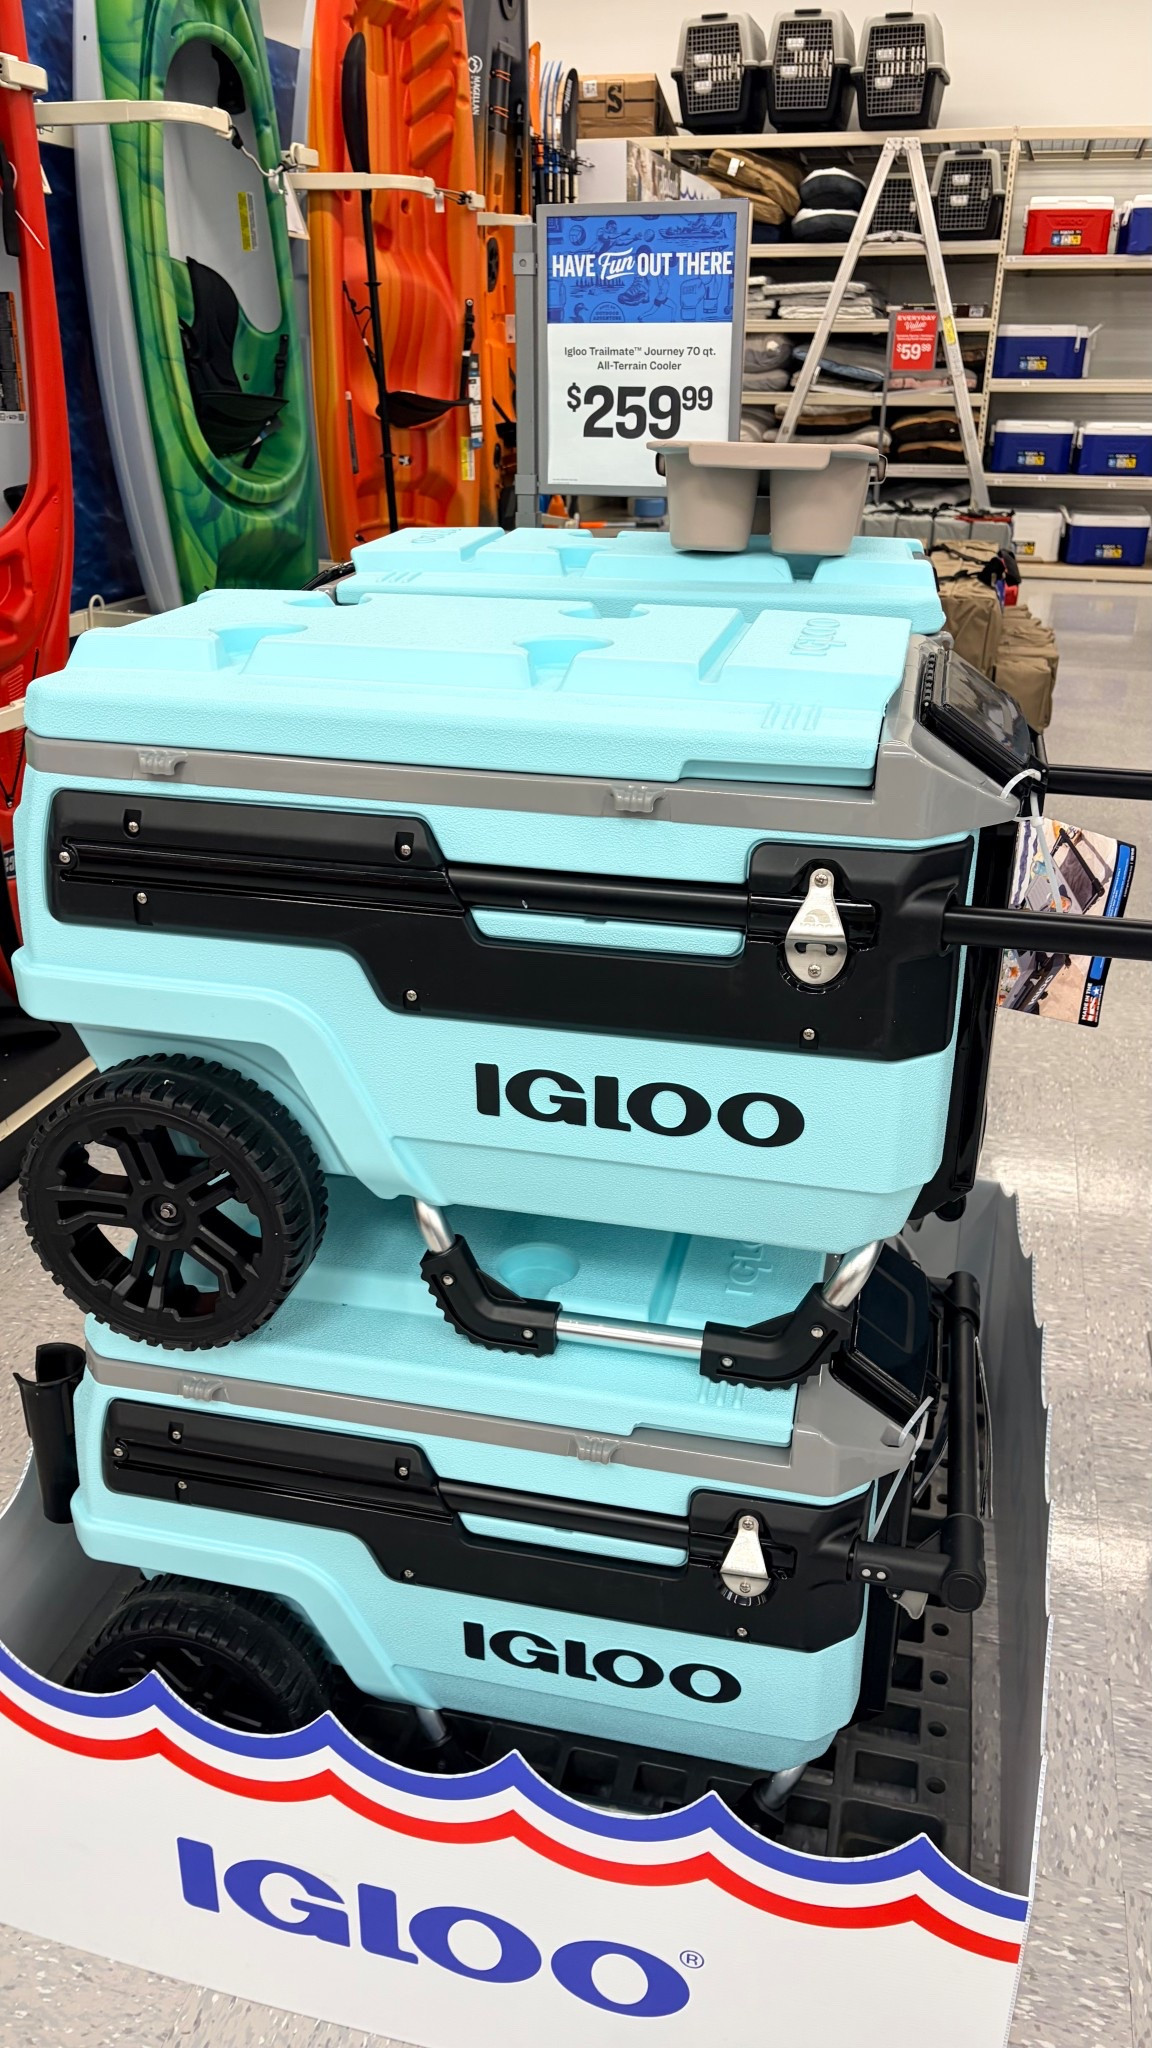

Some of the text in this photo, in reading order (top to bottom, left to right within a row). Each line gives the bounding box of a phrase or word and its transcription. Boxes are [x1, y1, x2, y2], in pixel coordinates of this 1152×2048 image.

[552, 247, 734, 281] HAVE Fun OUT THERE
[564, 346, 587, 357] Igloo
[644, 346, 685, 357] Journey
[687, 346, 700, 356] 70
[702, 347, 717, 357] qt.
[597, 360, 682, 371] All-Terrain Cooler
[475, 1062, 805, 1148] IGLOO
[463, 1620, 742, 1704] IGLOO
